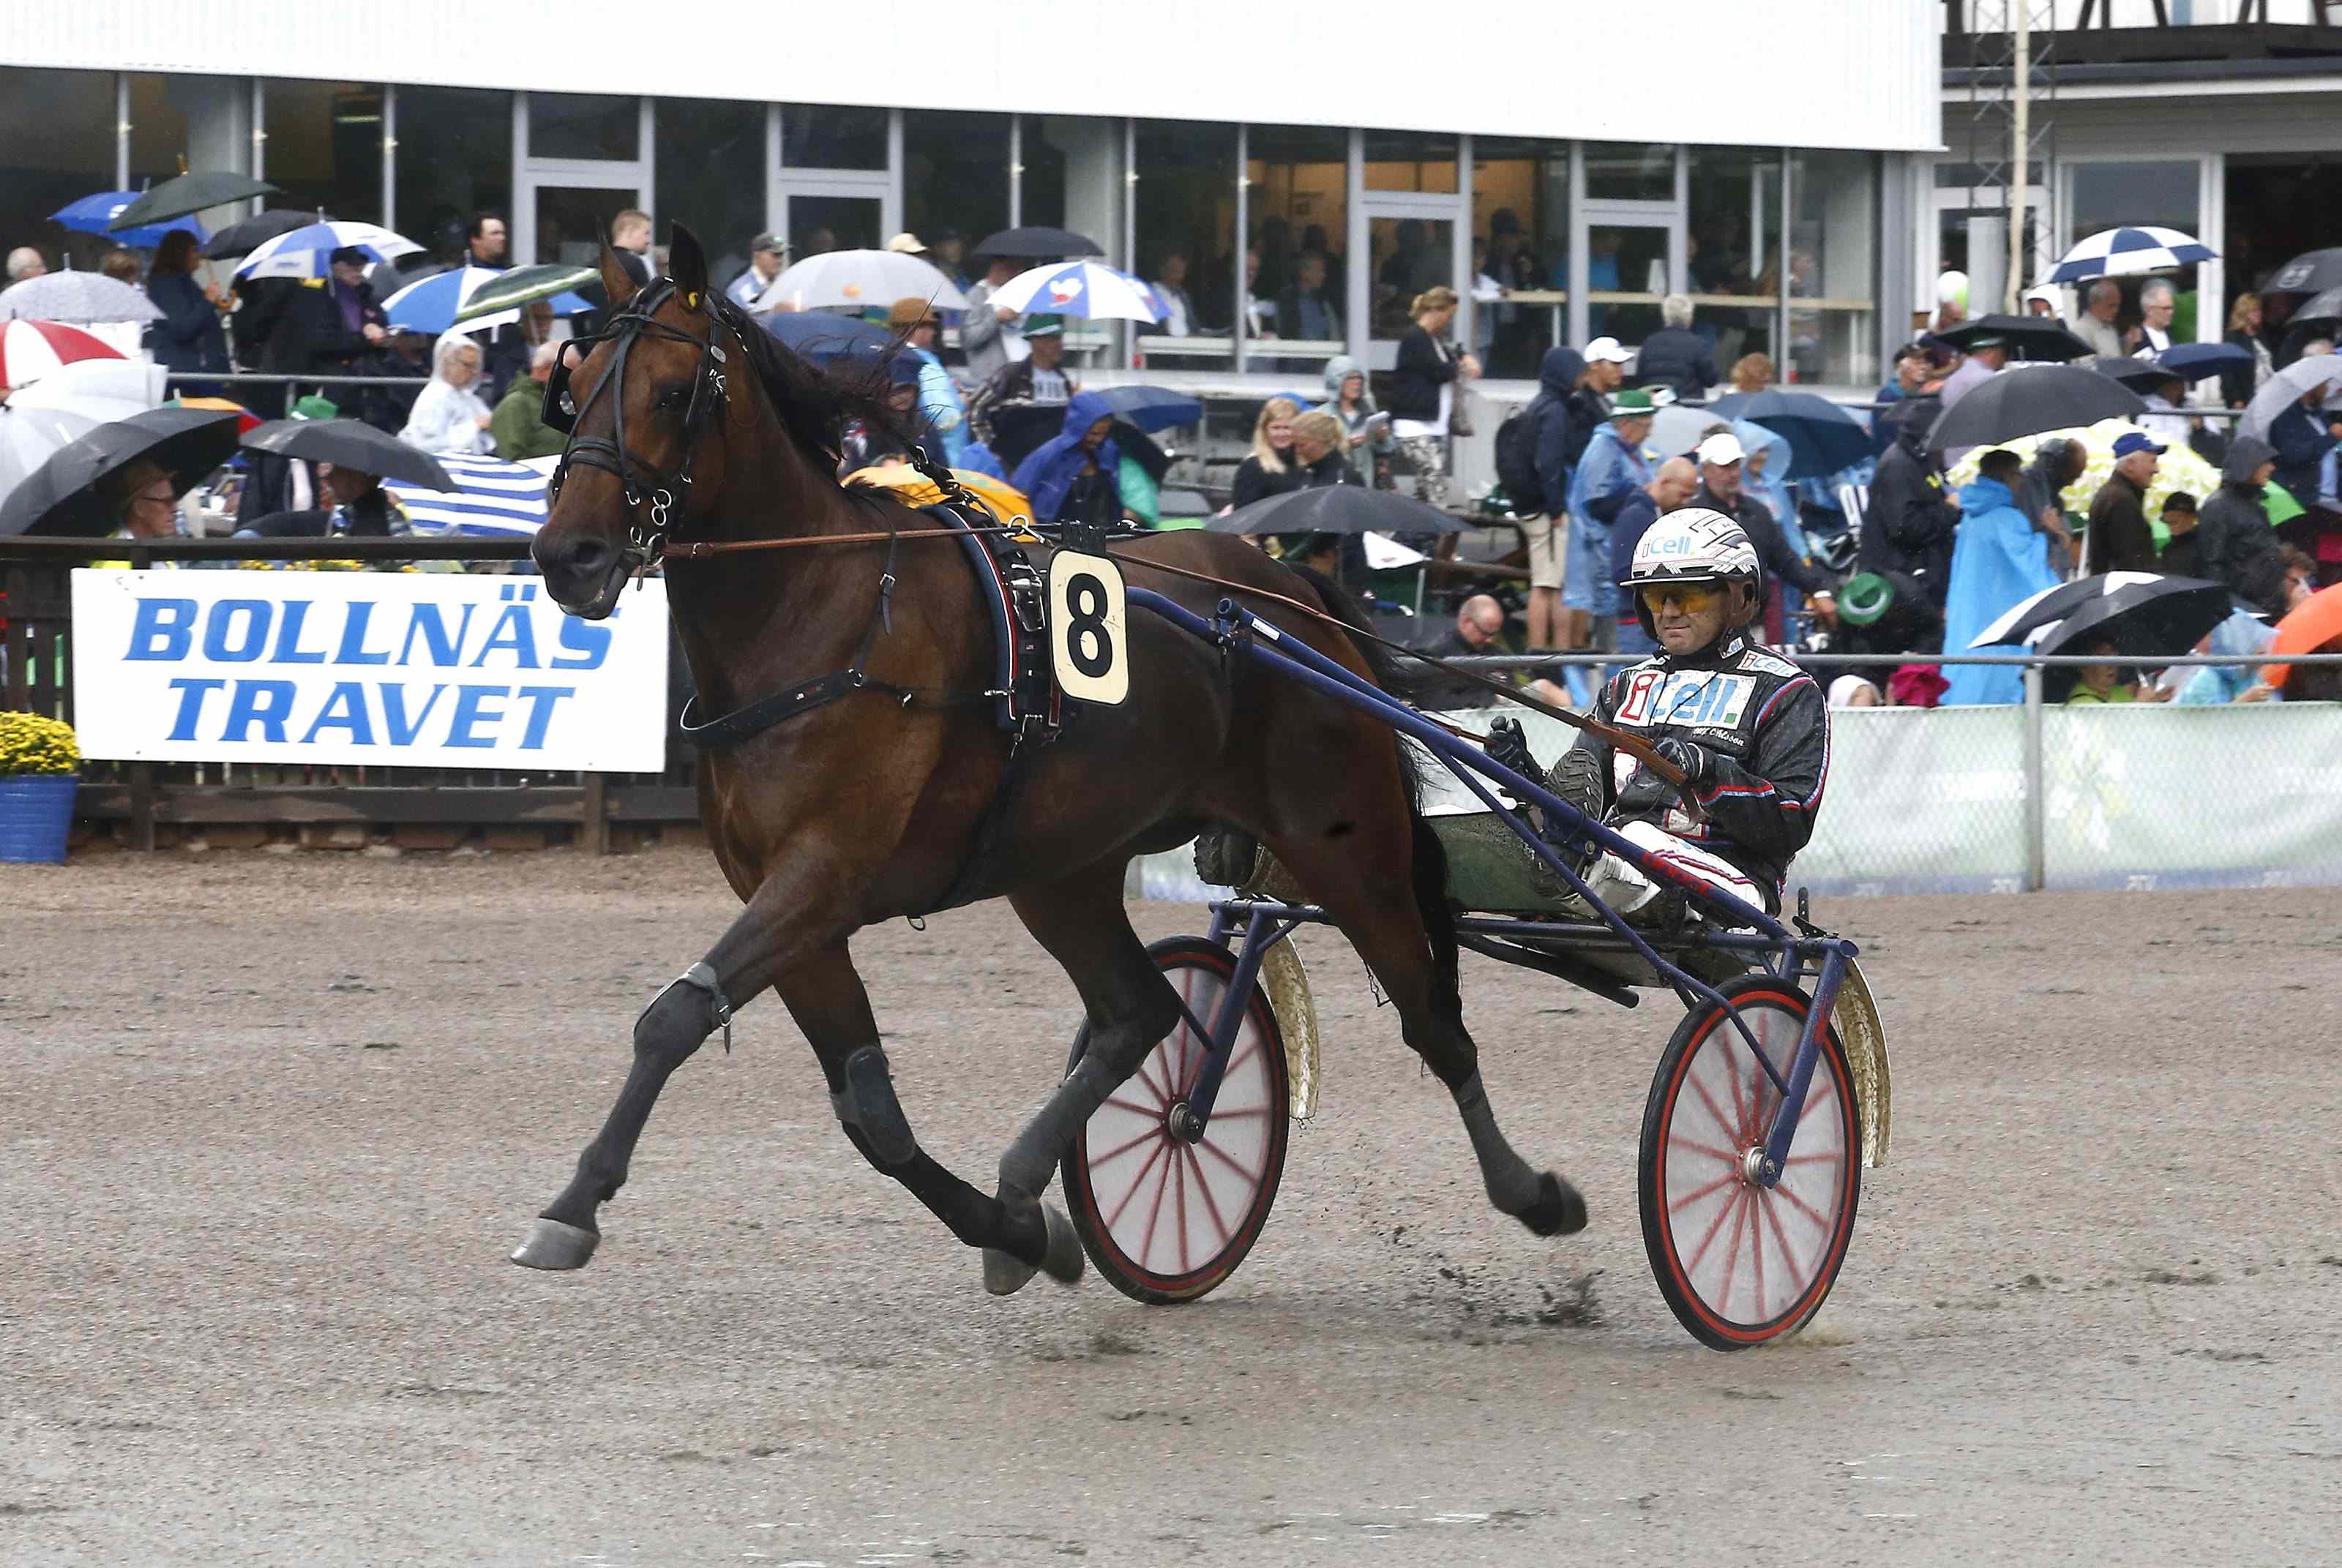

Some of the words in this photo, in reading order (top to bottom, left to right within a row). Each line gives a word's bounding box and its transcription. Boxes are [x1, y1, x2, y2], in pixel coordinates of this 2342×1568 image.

[122, 584, 621, 670] BOLLNÄS
[1066, 573, 1113, 678] 8
[166, 679, 575, 749] TRAVET
